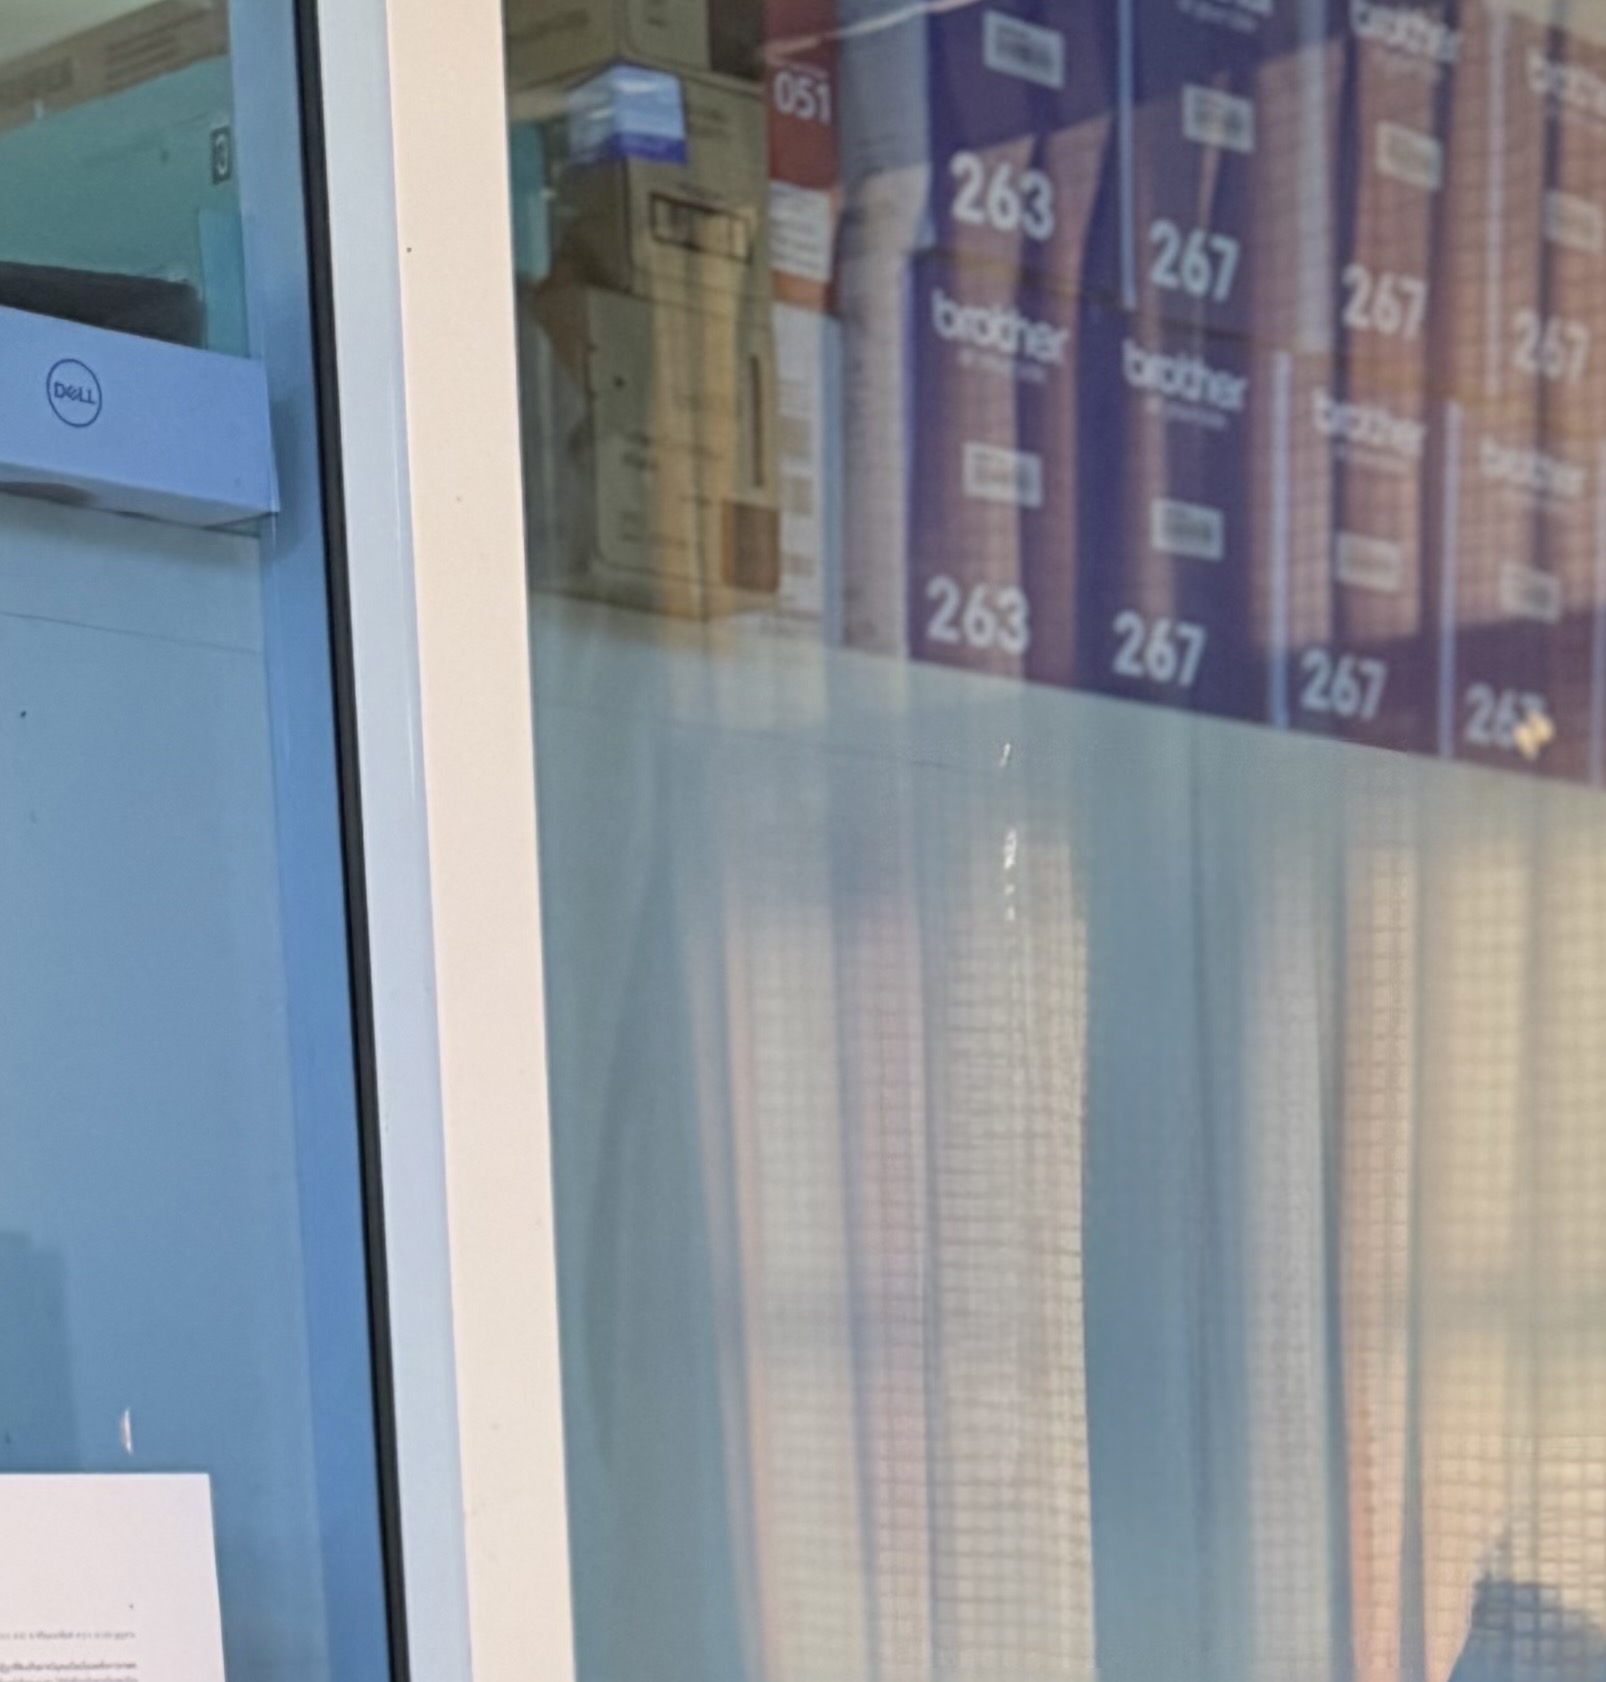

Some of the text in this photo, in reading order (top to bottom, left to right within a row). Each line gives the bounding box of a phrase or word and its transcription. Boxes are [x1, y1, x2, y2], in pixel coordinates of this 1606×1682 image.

[773, 70, 832, 124] 051
[950, 152, 1056, 241] 263
[1148, 219, 1241, 301] 267
[931, 289, 1069, 365] brother
[1342, 265, 1428, 338] 267
[1122, 339, 1249, 412] brother
[1511, 308, 1592, 385] 267
[53, 380, 98, 406] DELL
[926, 575, 1031, 658] 263
[1111, 611, 1207, 688] 267
[1302, 649, 1388, 722] 267
